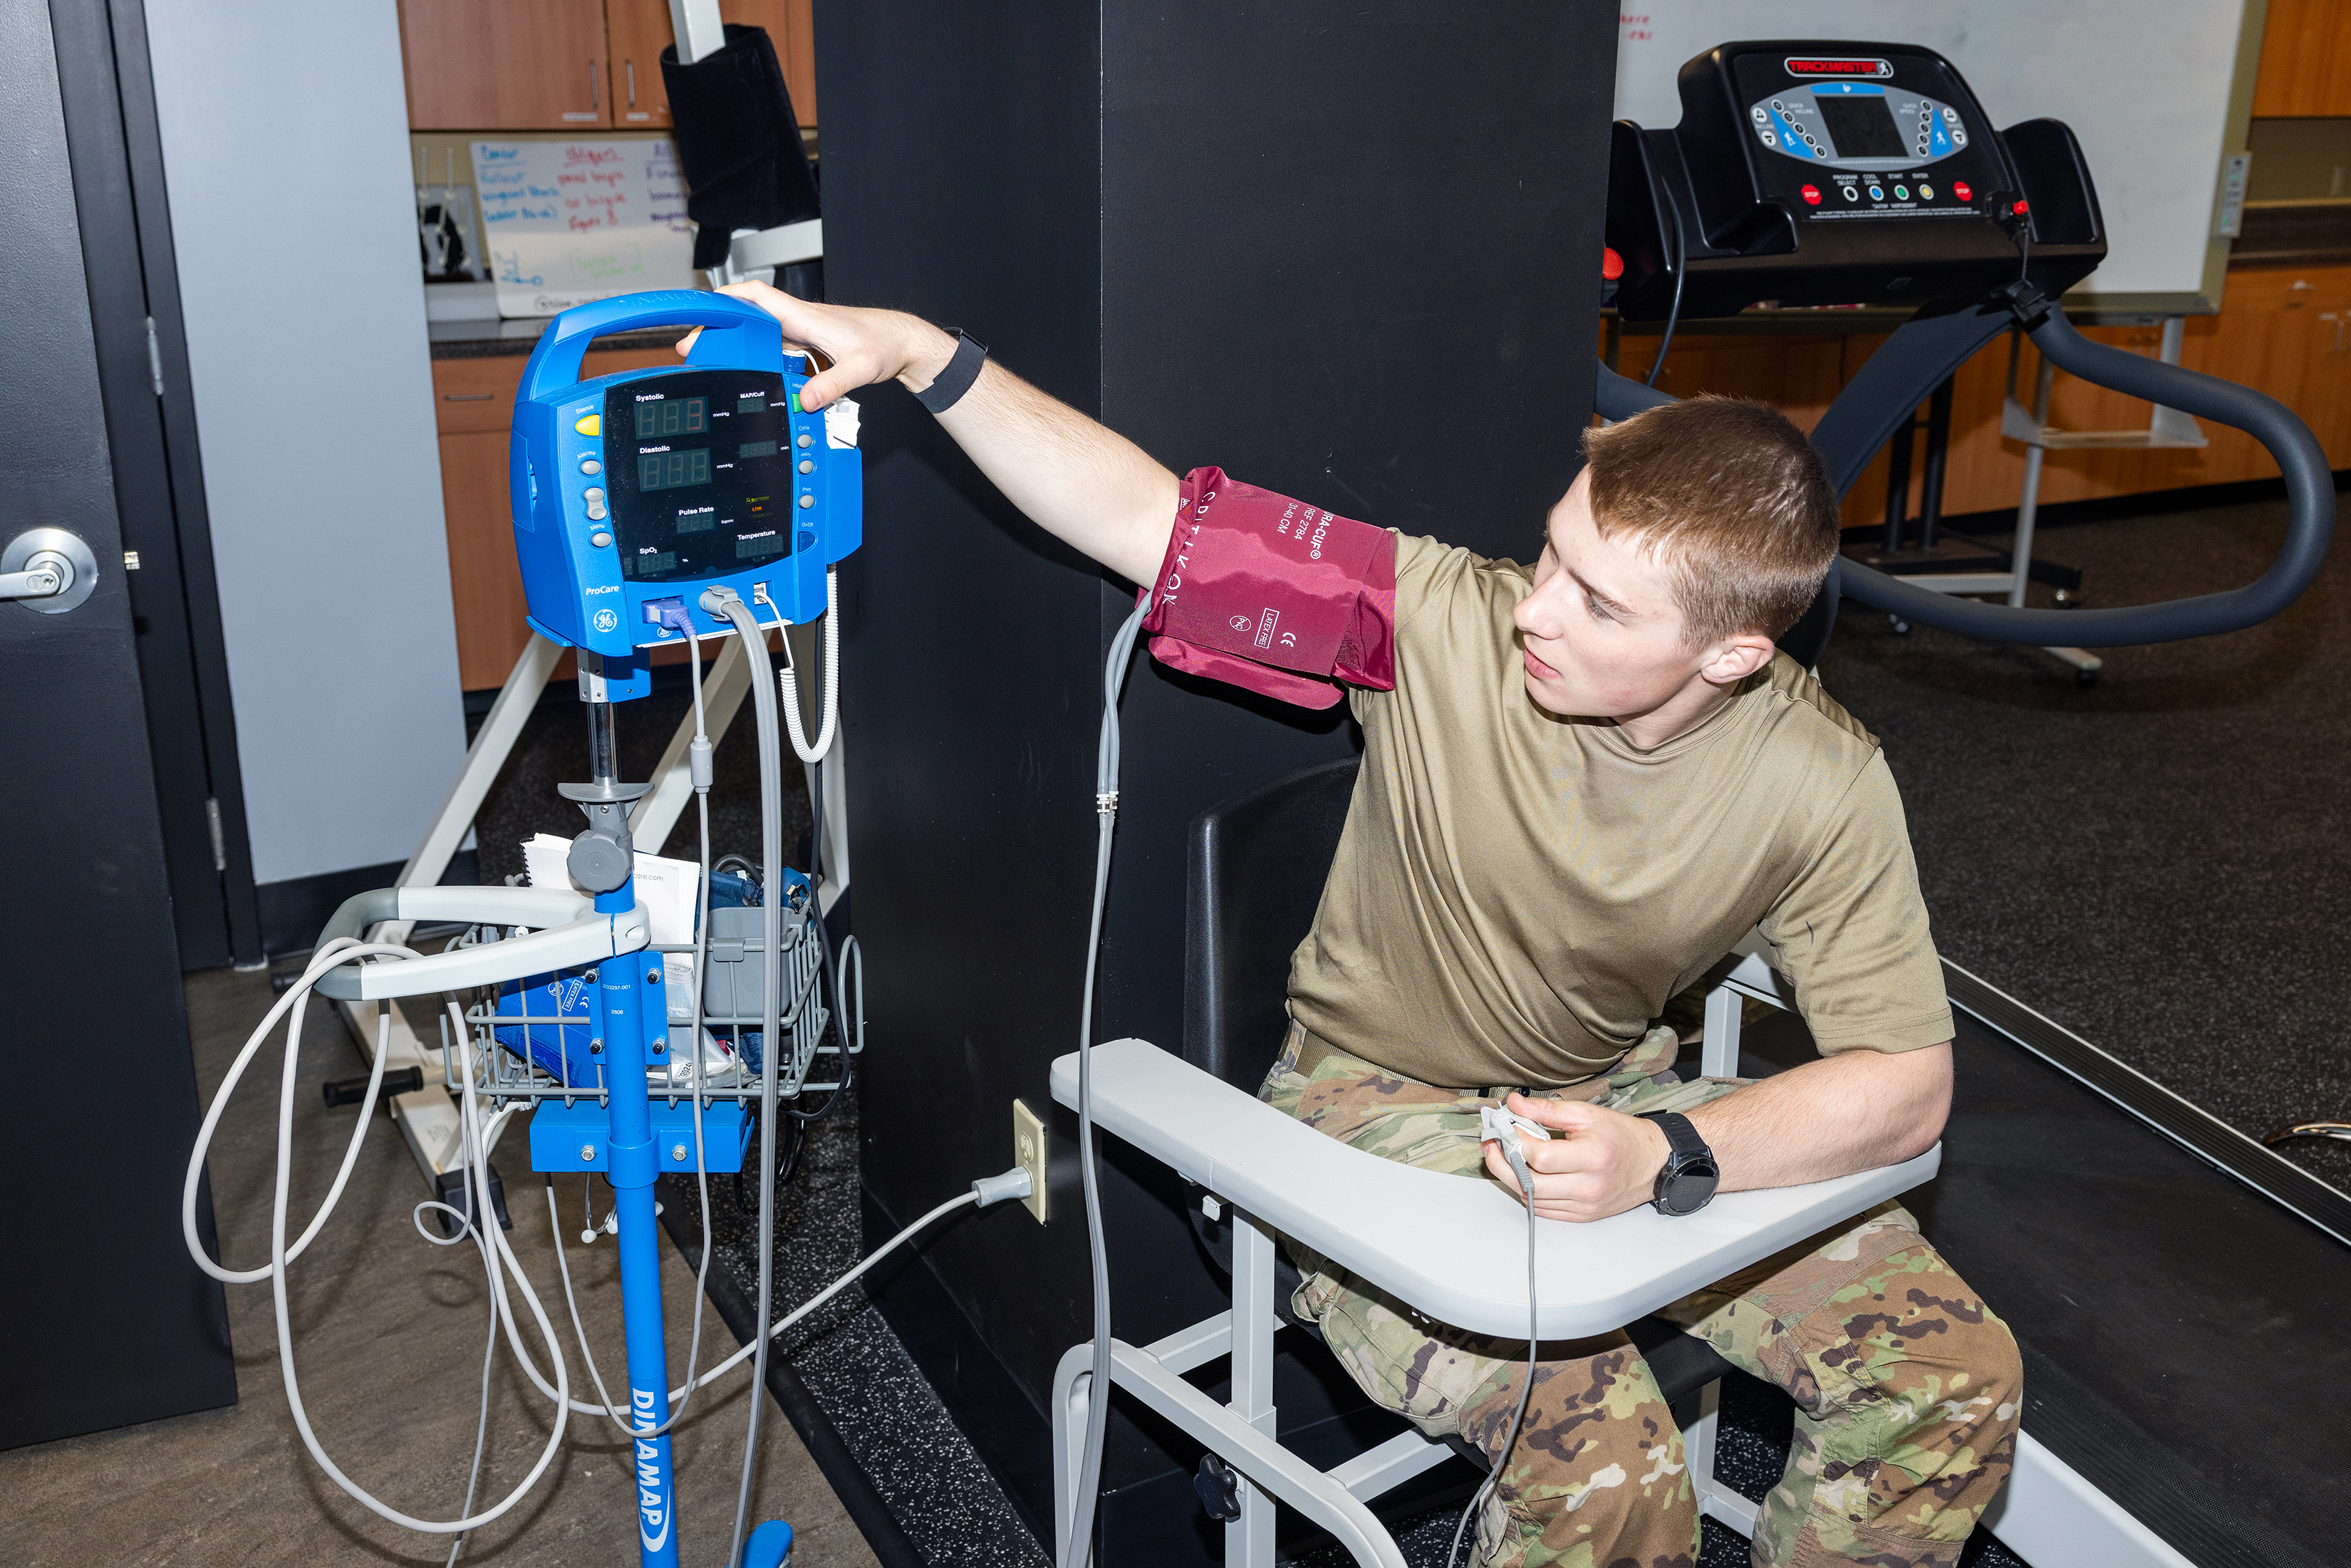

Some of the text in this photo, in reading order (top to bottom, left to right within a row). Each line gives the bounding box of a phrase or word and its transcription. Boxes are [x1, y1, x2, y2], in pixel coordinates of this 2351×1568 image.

[1788, 60, 1877, 73] TRACKMASTER
[615, 291, 701, 311] DINAMAP
[635, 393, 665, 403] Systolic
[575, 404, 595, 415] Silence
[576, 450, 597, 460] Alarms
[639, 445, 671, 455] Diastolic
[678, 508, 698, 516] Pulse
[1277, 502, 1298, 534] 31-40 CM
[1294, 507, 1316, 540] REF 2784
[737, 530, 776, 541] Temperature
[586, 585, 621, 596] ProCare
[1258, 613, 1275, 646] LATEX FREE
[565, 982, 580, 1009] LATEX FREE
